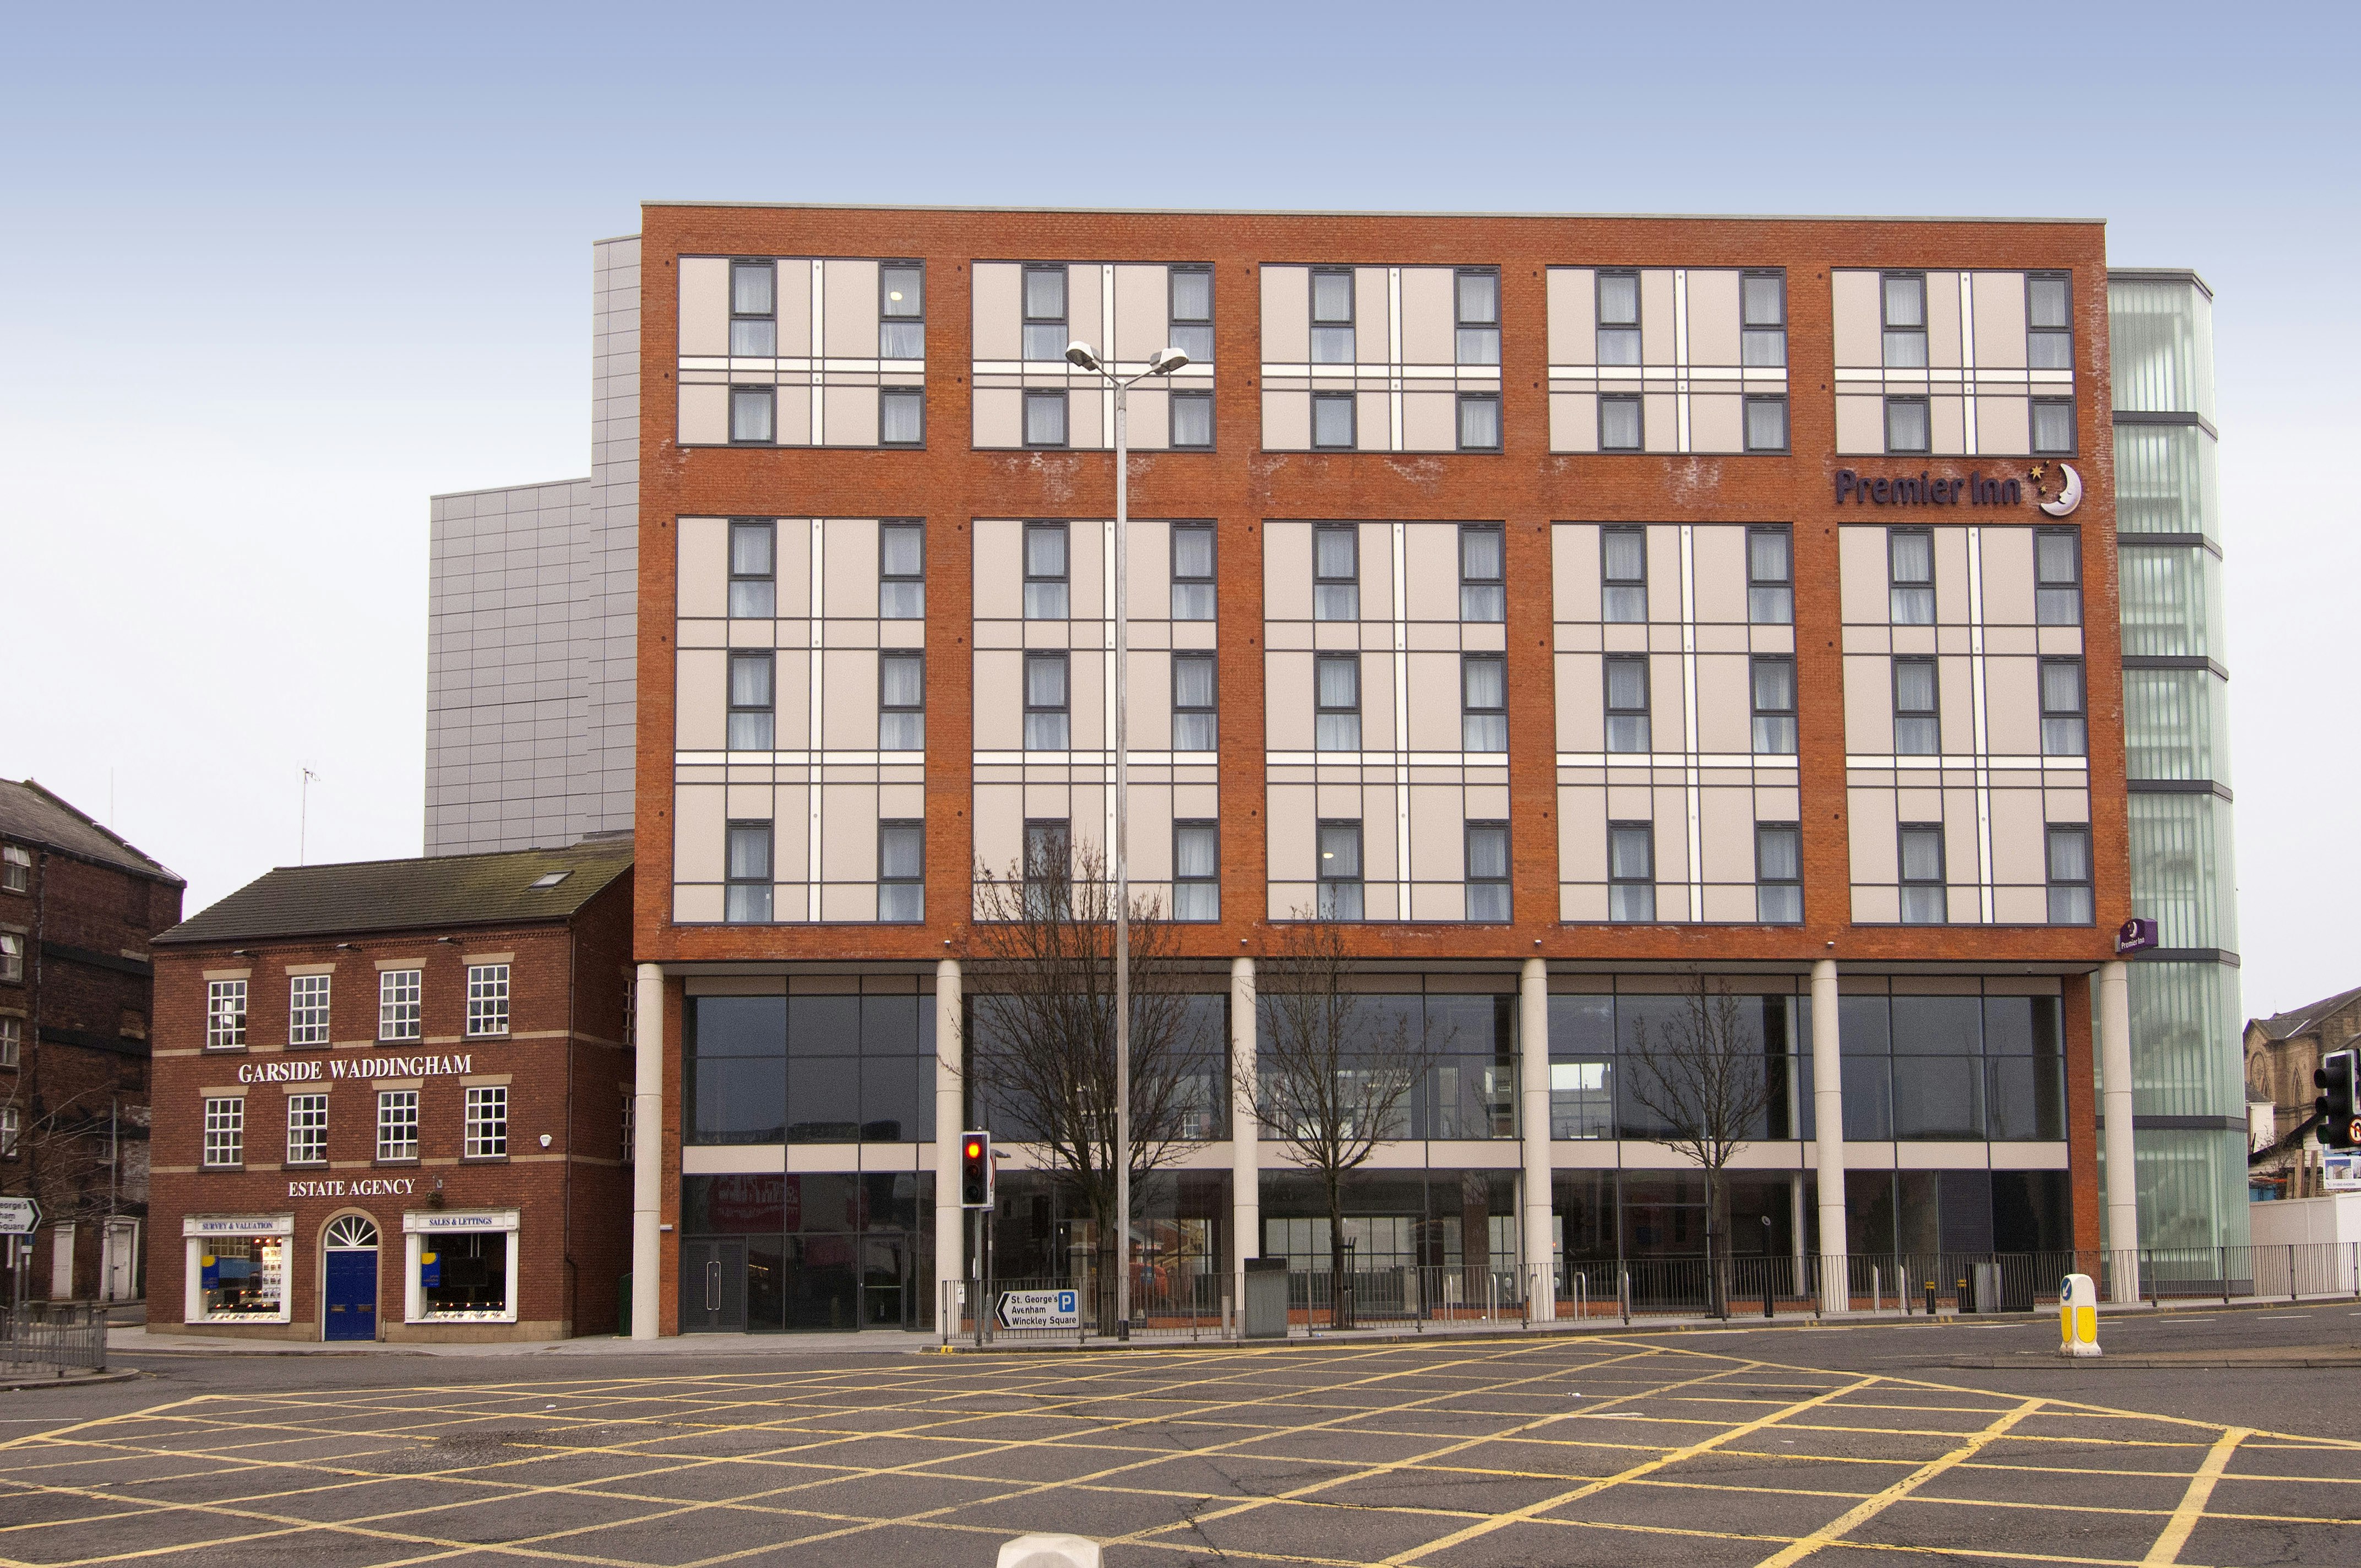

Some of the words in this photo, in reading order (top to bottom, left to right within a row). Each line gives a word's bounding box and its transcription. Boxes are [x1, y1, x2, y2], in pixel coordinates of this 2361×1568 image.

[1836, 469, 1965, 504] Premier
[1971, 470, 2022, 505] Inn
[238, 1061, 322, 1083] GARSIDE
[330, 1054, 472, 1079] WADDINGHAM
[289, 1180, 345, 1197] ESTATE
[349, 1178, 416, 1195] AGENCY
[202, 1222, 227, 1230] SURVEY
[1011, 1295, 1022, 1304] St.
[1025, 1294, 1058, 1304] George's
[1012, 1306, 1045, 1314] Avenham
[1012, 1316, 1046, 1326] Winckley
[1049, 1316, 1076, 1326] Square
